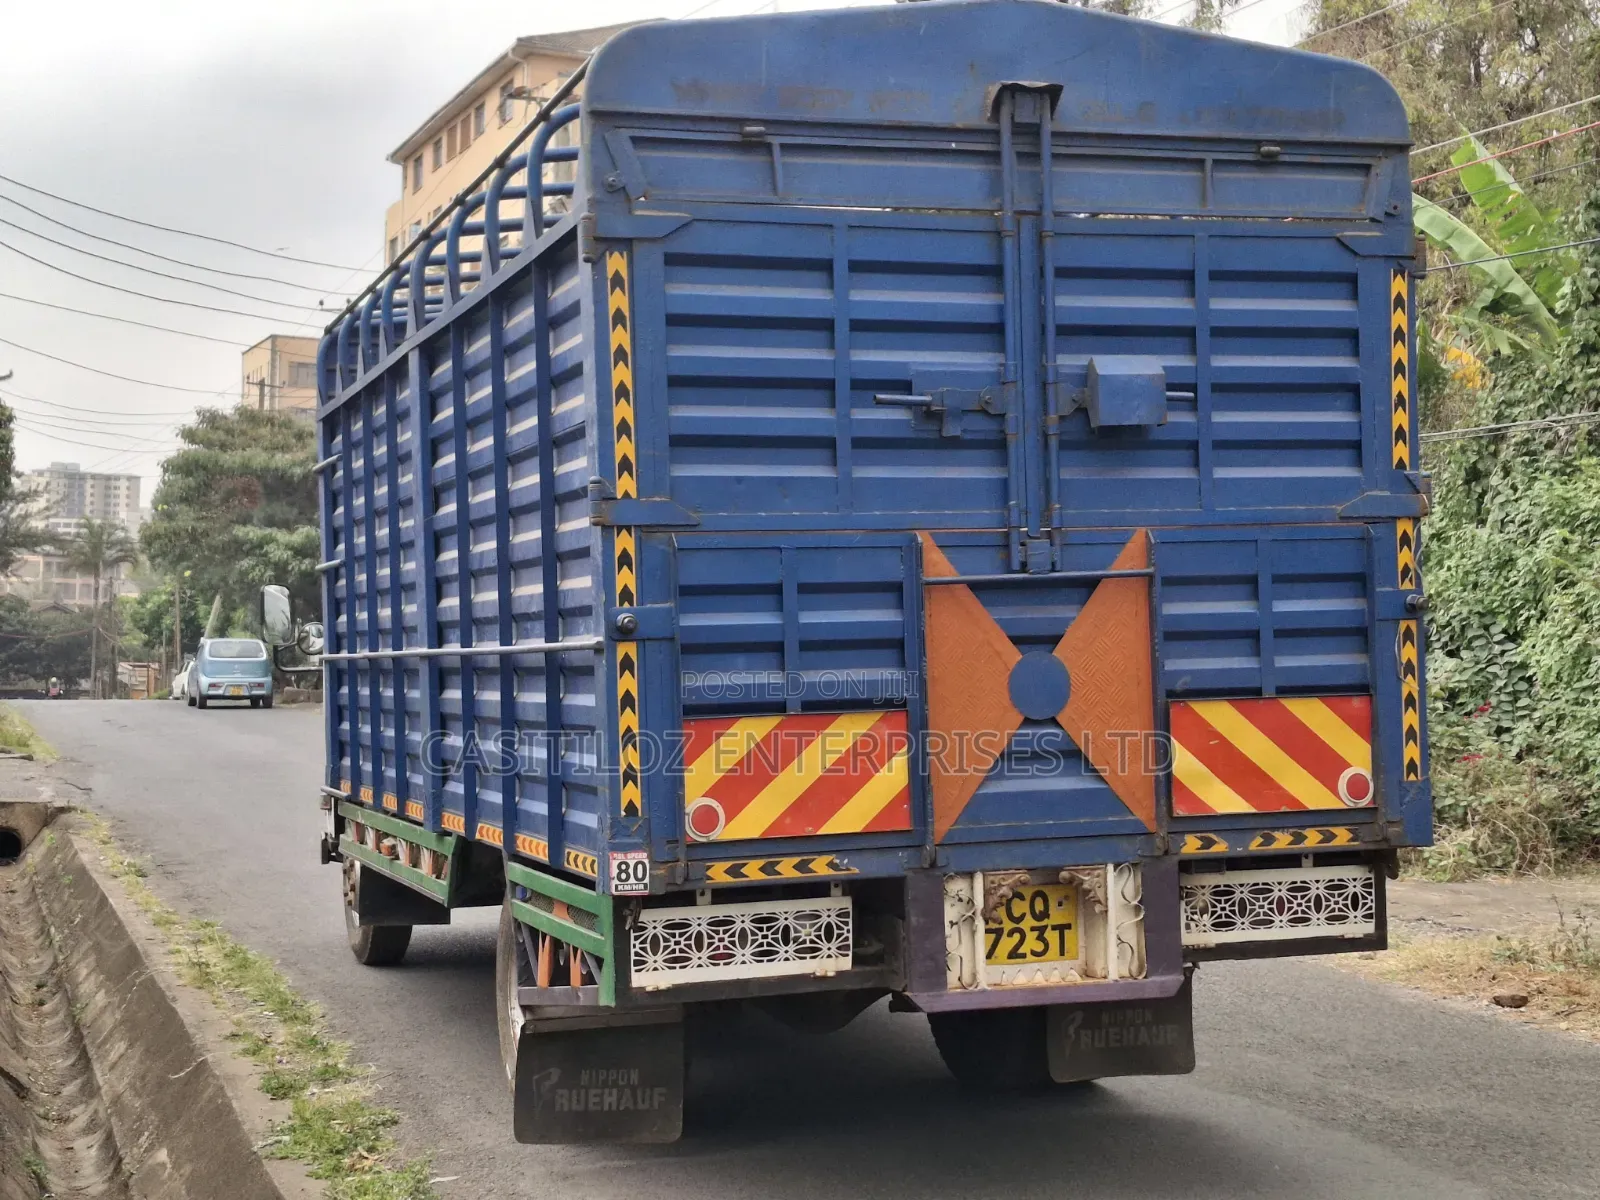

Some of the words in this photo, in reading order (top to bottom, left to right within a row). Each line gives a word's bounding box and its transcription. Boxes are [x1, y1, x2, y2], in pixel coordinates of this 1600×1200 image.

[616, 860, 647, 882] 80
[985, 889, 1051, 925] CQ
[985, 923, 1072, 960] 723T
[580, 1068, 640, 1085] NIPPON
